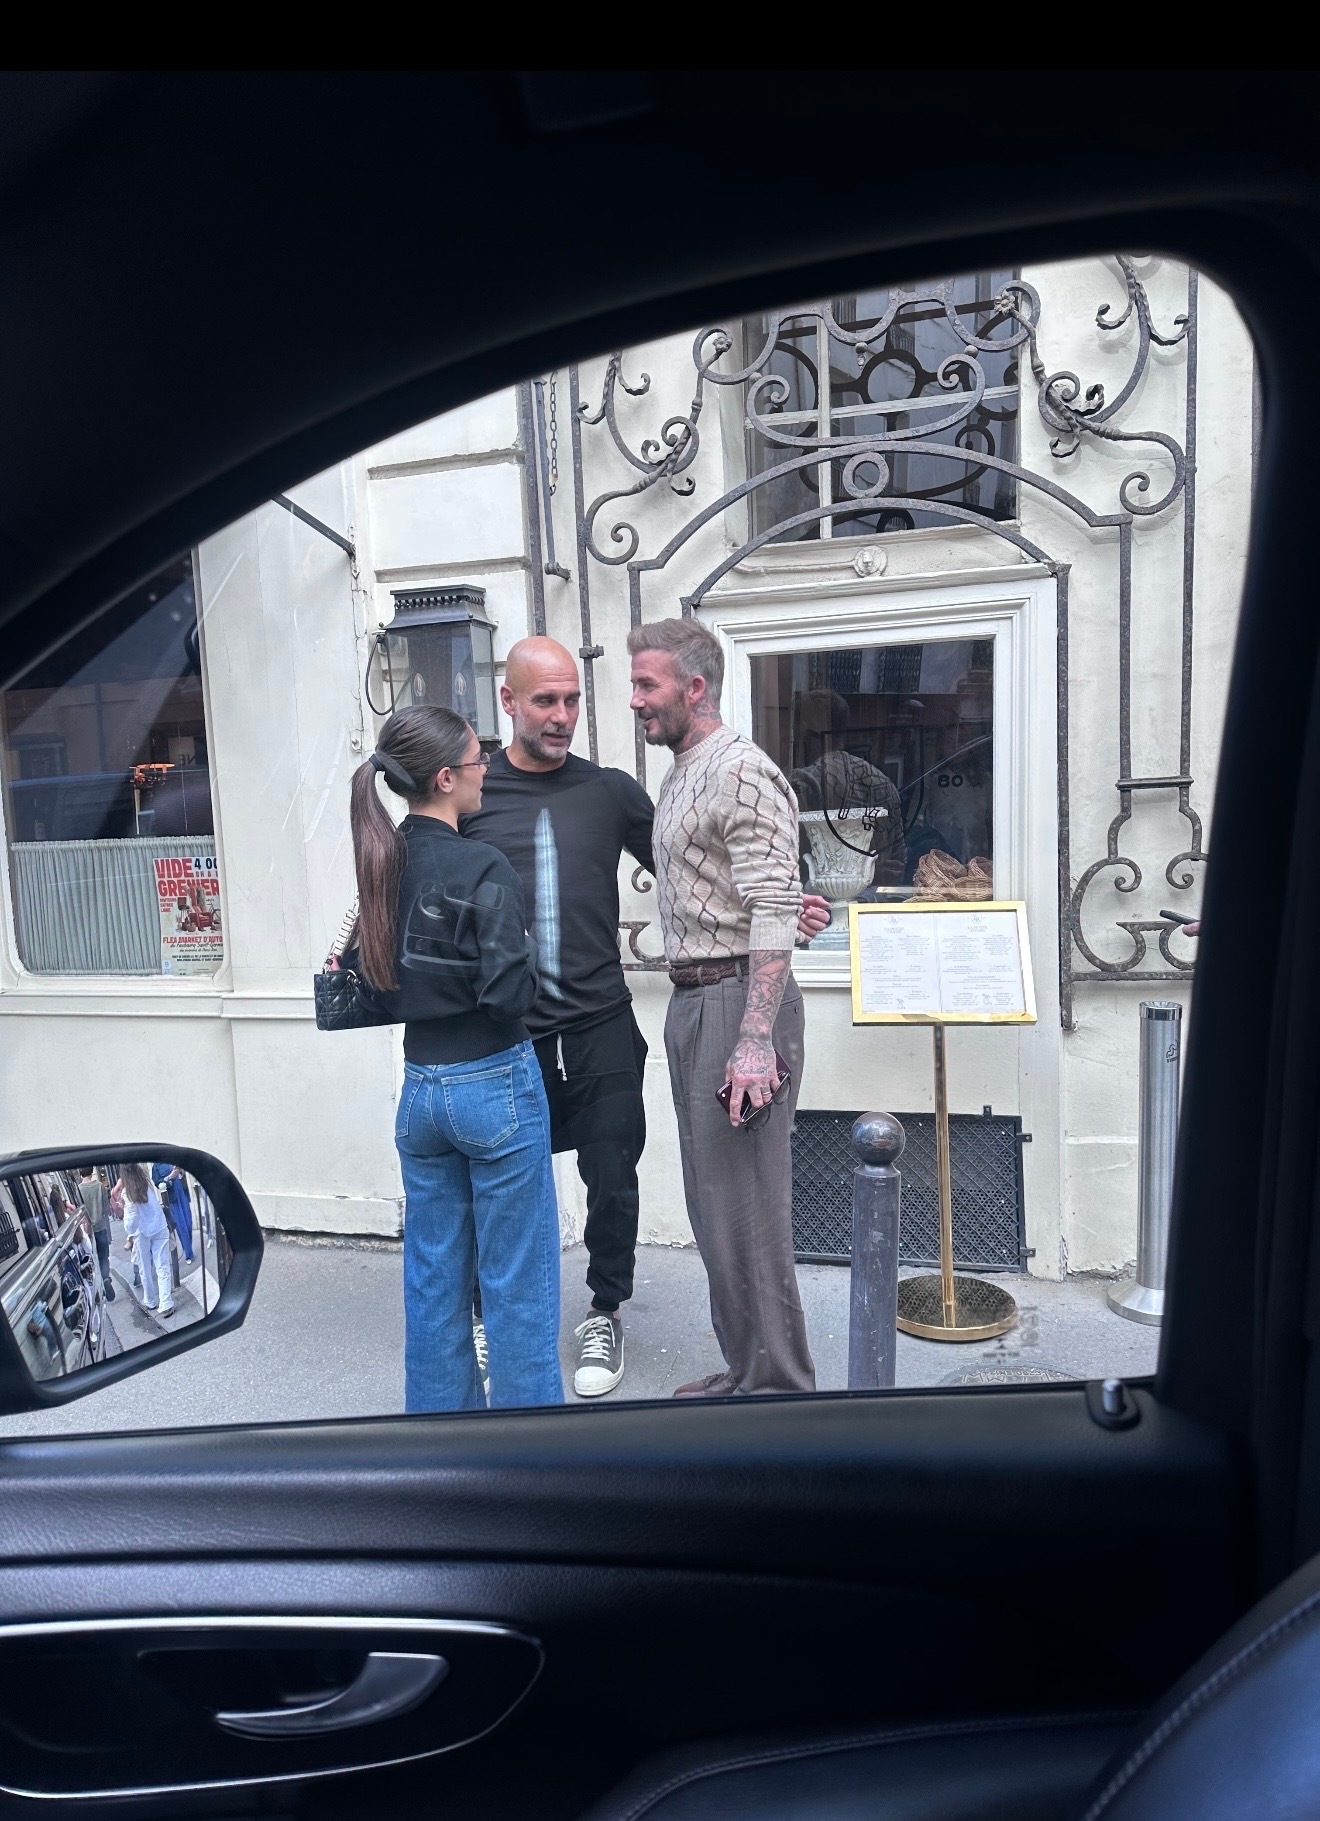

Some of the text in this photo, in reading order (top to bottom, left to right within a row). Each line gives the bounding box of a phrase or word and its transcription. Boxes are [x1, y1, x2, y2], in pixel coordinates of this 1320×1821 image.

[938, 774, 964, 788] 80
[154, 858, 194, 878] VIDE
[194, 858, 202, 870] 4
[163, 936, 177, 944] FLEA
[178, 936, 202, 944] MARKET
